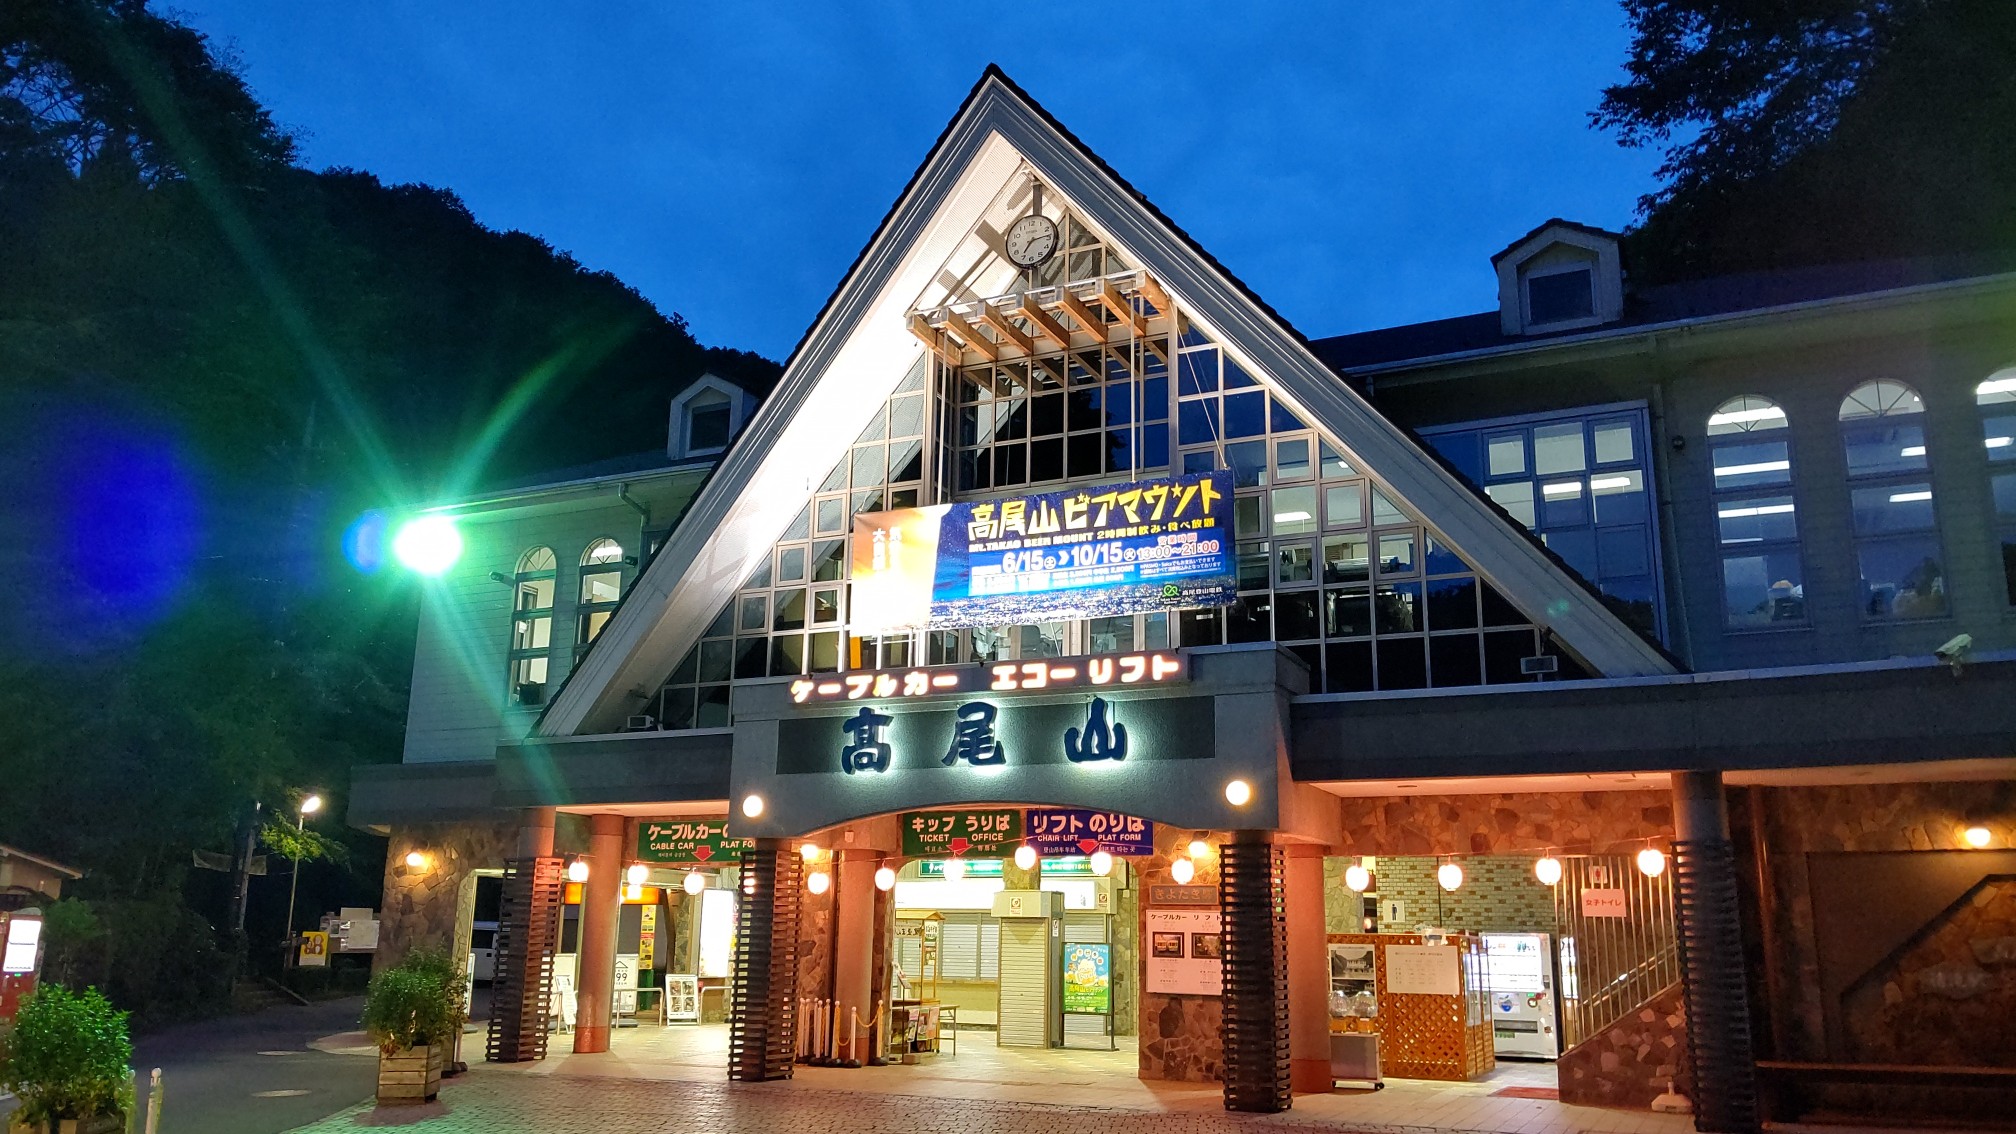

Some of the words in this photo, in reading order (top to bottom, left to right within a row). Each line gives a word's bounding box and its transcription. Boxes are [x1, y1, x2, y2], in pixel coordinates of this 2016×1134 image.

[968, 479, 1221, 541] 高尾山ビアマウント
[1023, 537, 1052, 548] BEER
[1053, 532, 1095, 545] MOUNT
[1002, 550, 1044, 573] 6/15
[1071, 542, 1122, 567] 10/15
[790, 670, 958, 703] ケーブルカー
[991, 662, 1077, 691] エコー
[1088, 654, 1179, 685] リフト
[911, 815, 956, 832] キップ
[966, 814, 1011, 832] うりば
[1033, 814, 1084, 833] リフト
[919, 833, 950, 842] TICKET
[971, 832, 1004, 841] OFFICE
[1037, 834, 1060, 842] CHAIR
[1120, 833, 1142, 841] FORM
[650, 842, 675, 850] CABLE
[677, 841, 694, 849] CAR
[720, 841, 740, 849] PLAT
[742, 840, 756, 848] FO
[1585, 899, 1622, 907] 女子トイレ
[1150, 913, 1187, 921] ケーブルカー
